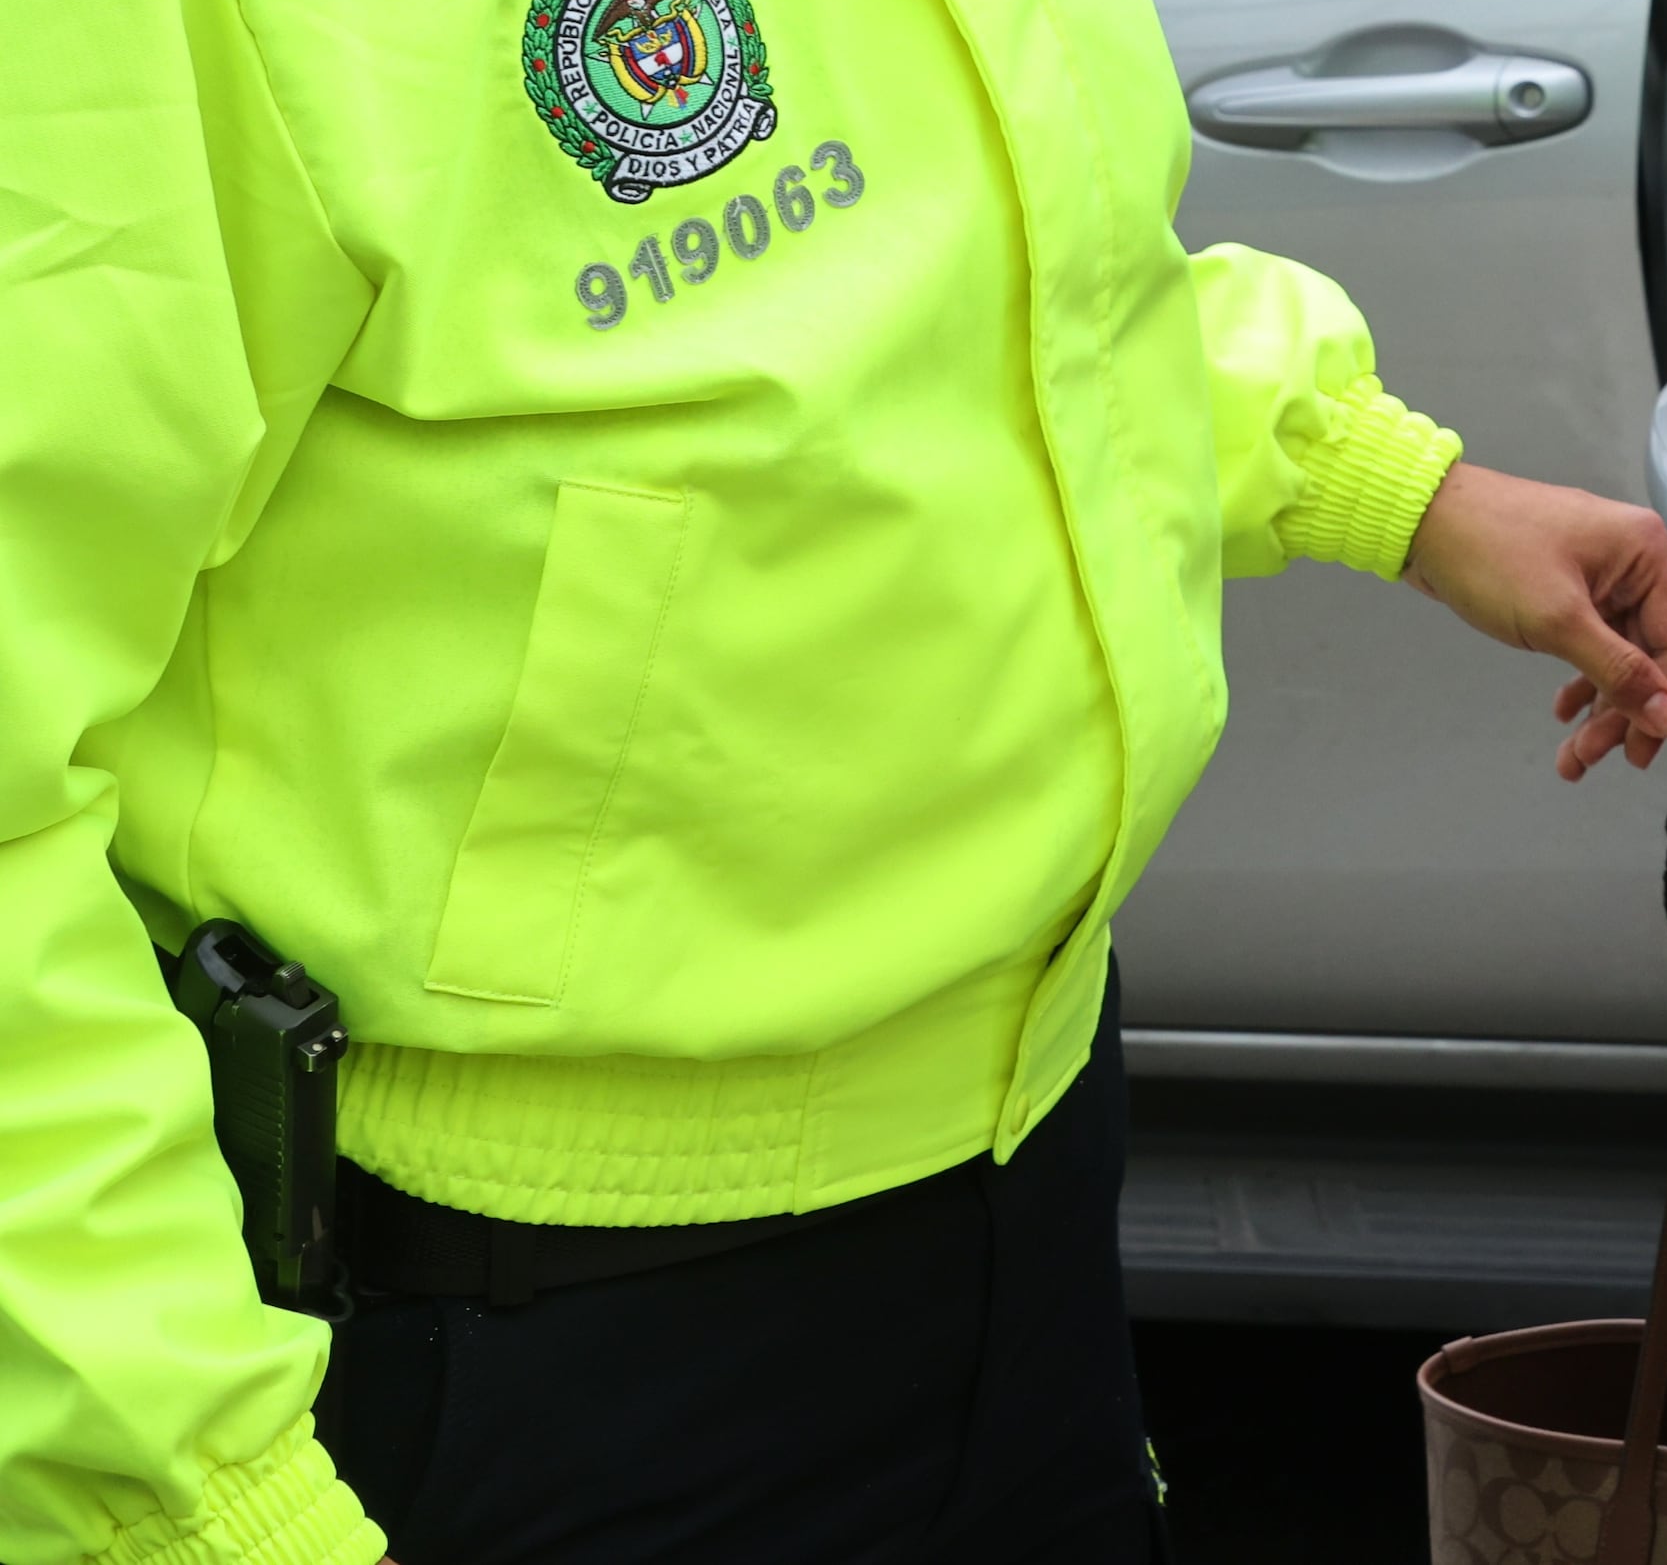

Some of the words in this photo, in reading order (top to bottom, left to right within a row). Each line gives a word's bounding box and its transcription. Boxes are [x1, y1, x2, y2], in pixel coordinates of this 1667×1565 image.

[691, 48, 740, 141] NACIONAL
[628, 156, 682, 178] DIOS
[685, 153, 699, 173] Y
[575, 140, 866, 330] 919063
